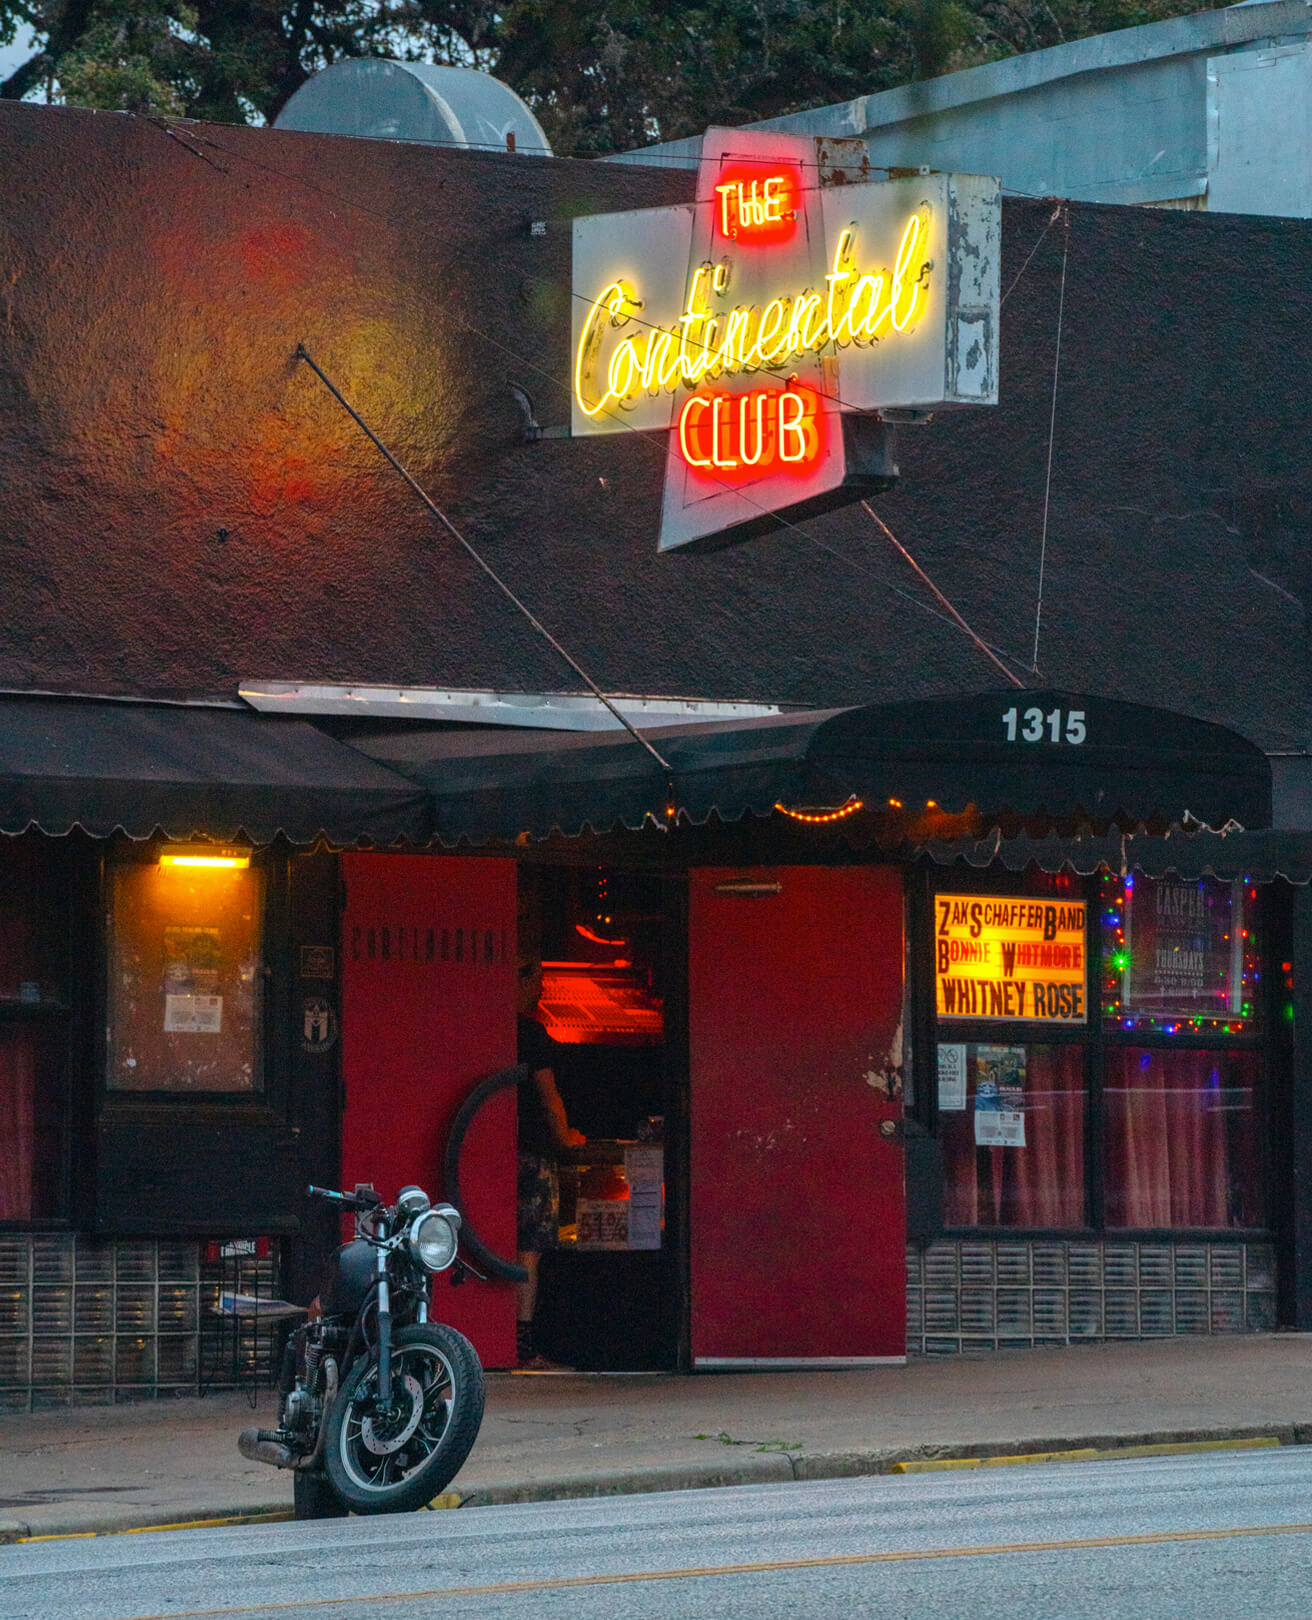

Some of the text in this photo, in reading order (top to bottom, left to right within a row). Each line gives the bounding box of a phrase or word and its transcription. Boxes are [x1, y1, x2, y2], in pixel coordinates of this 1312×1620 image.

[715, 177, 785, 237] THE
[575, 214, 920, 415] Continental
[679, 392, 807, 467] CLUB
[1002, 707, 1087, 744] 1315
[938, 901, 1085, 941] ZAK SCHAFFER BAND
[937, 939, 1082, 977] BONNIE WHITMORE
[941, 978, 1084, 1019] WHITNEY ROSE
